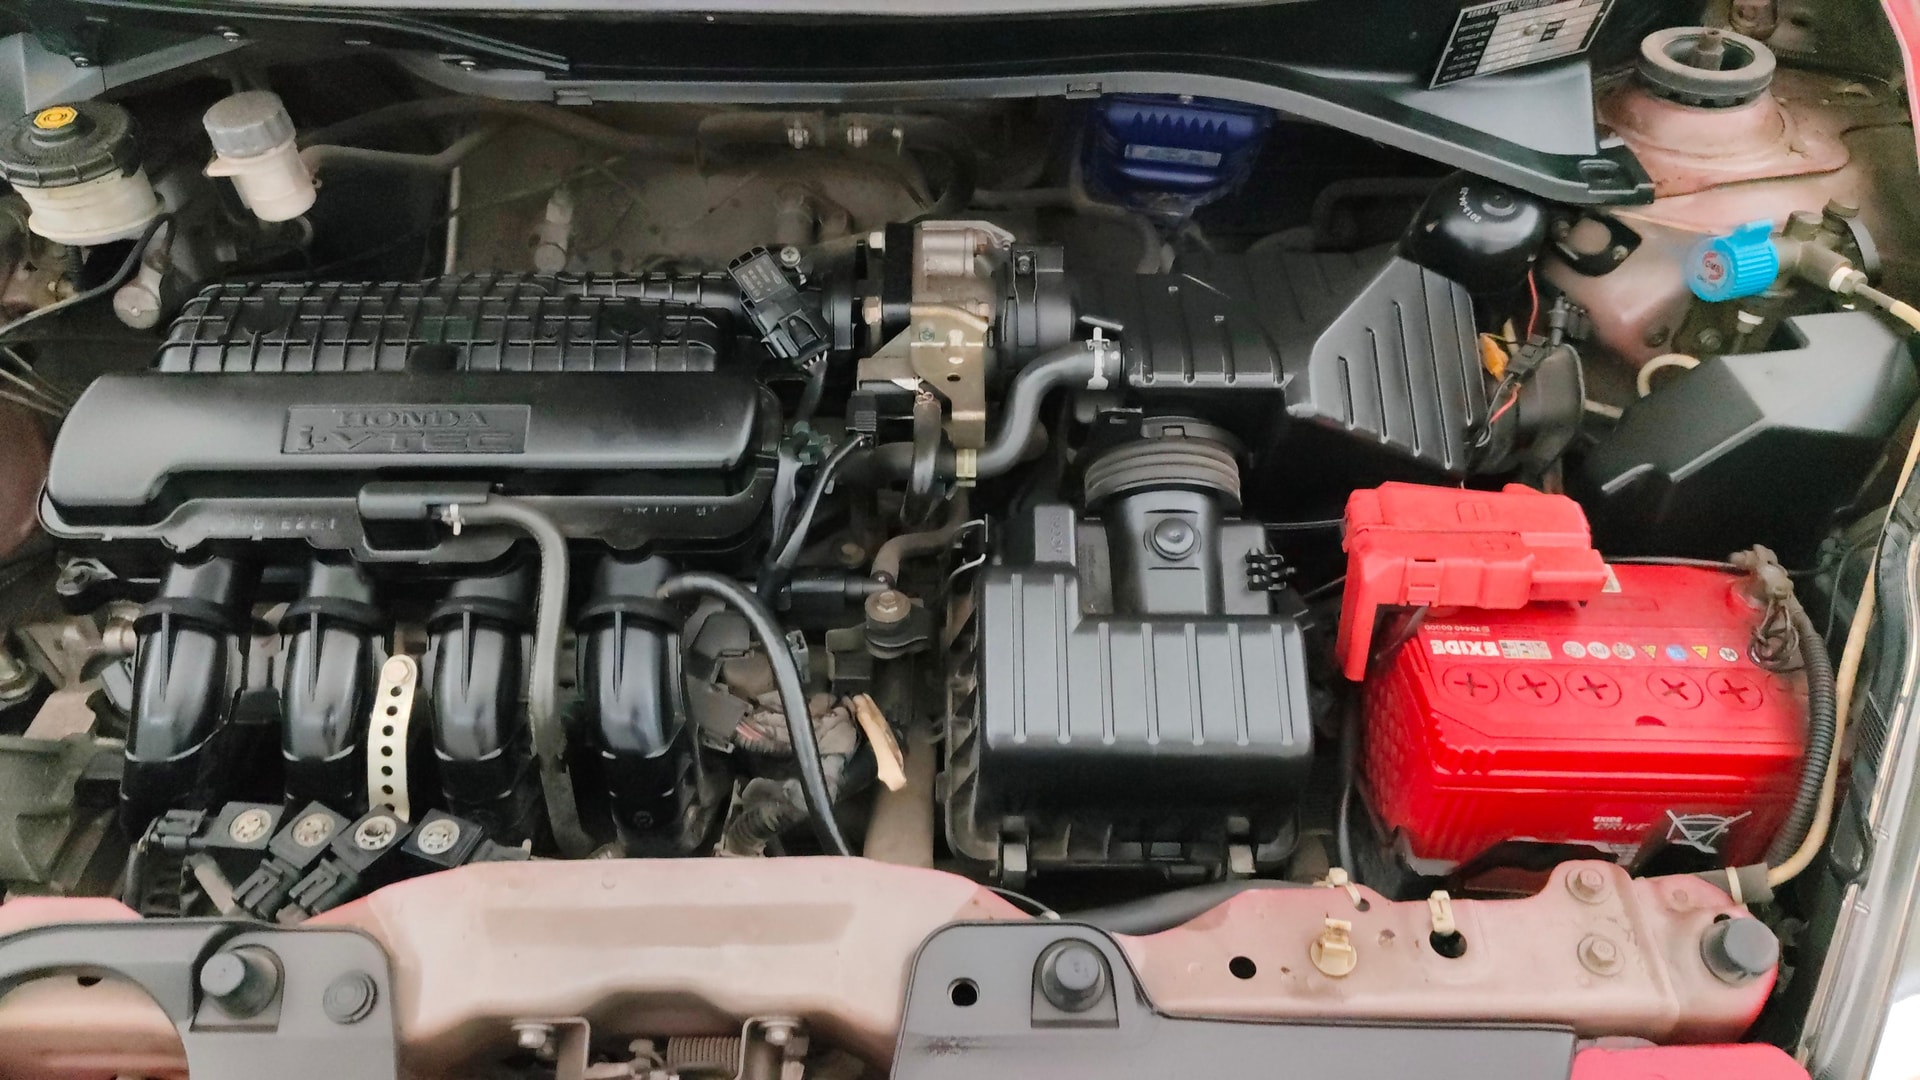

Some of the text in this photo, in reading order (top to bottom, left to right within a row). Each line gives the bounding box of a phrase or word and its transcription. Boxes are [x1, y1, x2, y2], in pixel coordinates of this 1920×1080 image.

[336, 410, 490, 428] HONDA
[298, 425, 514, 452] i-VTEC
[1430, 640, 1500, 656] EXIDE
[1593, 823, 1651, 831] DRIVE
